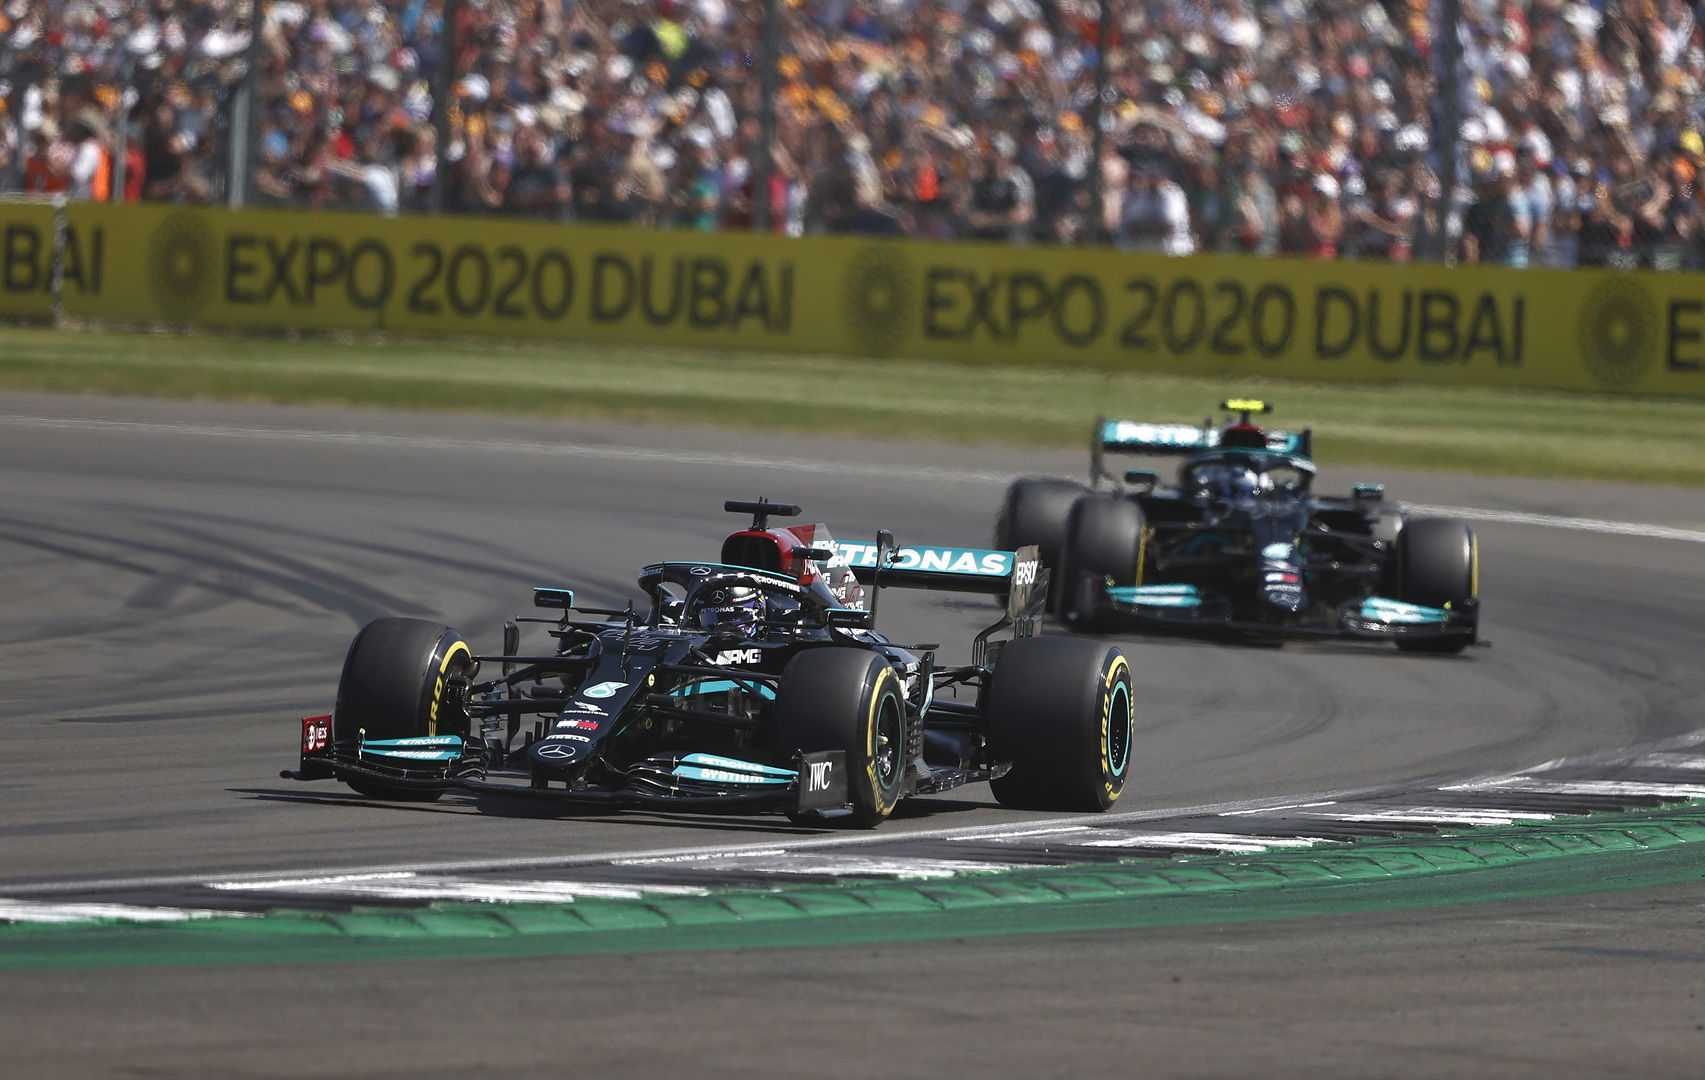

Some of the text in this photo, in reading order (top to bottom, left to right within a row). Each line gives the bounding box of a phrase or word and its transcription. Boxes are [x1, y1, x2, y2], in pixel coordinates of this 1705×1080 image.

[225, 233, 794, 334] EXPO 2020 DUBAI
[924, 266, 1526, 368] EXPO 2020 DUBAI
[728, 649, 762, 665] AMG
[428, 675, 443, 737] ERO
[396, 737, 452, 746] PETRONAS
[697, 755, 764, 772] PETRONAS
[808, 761, 833, 792] IWC
